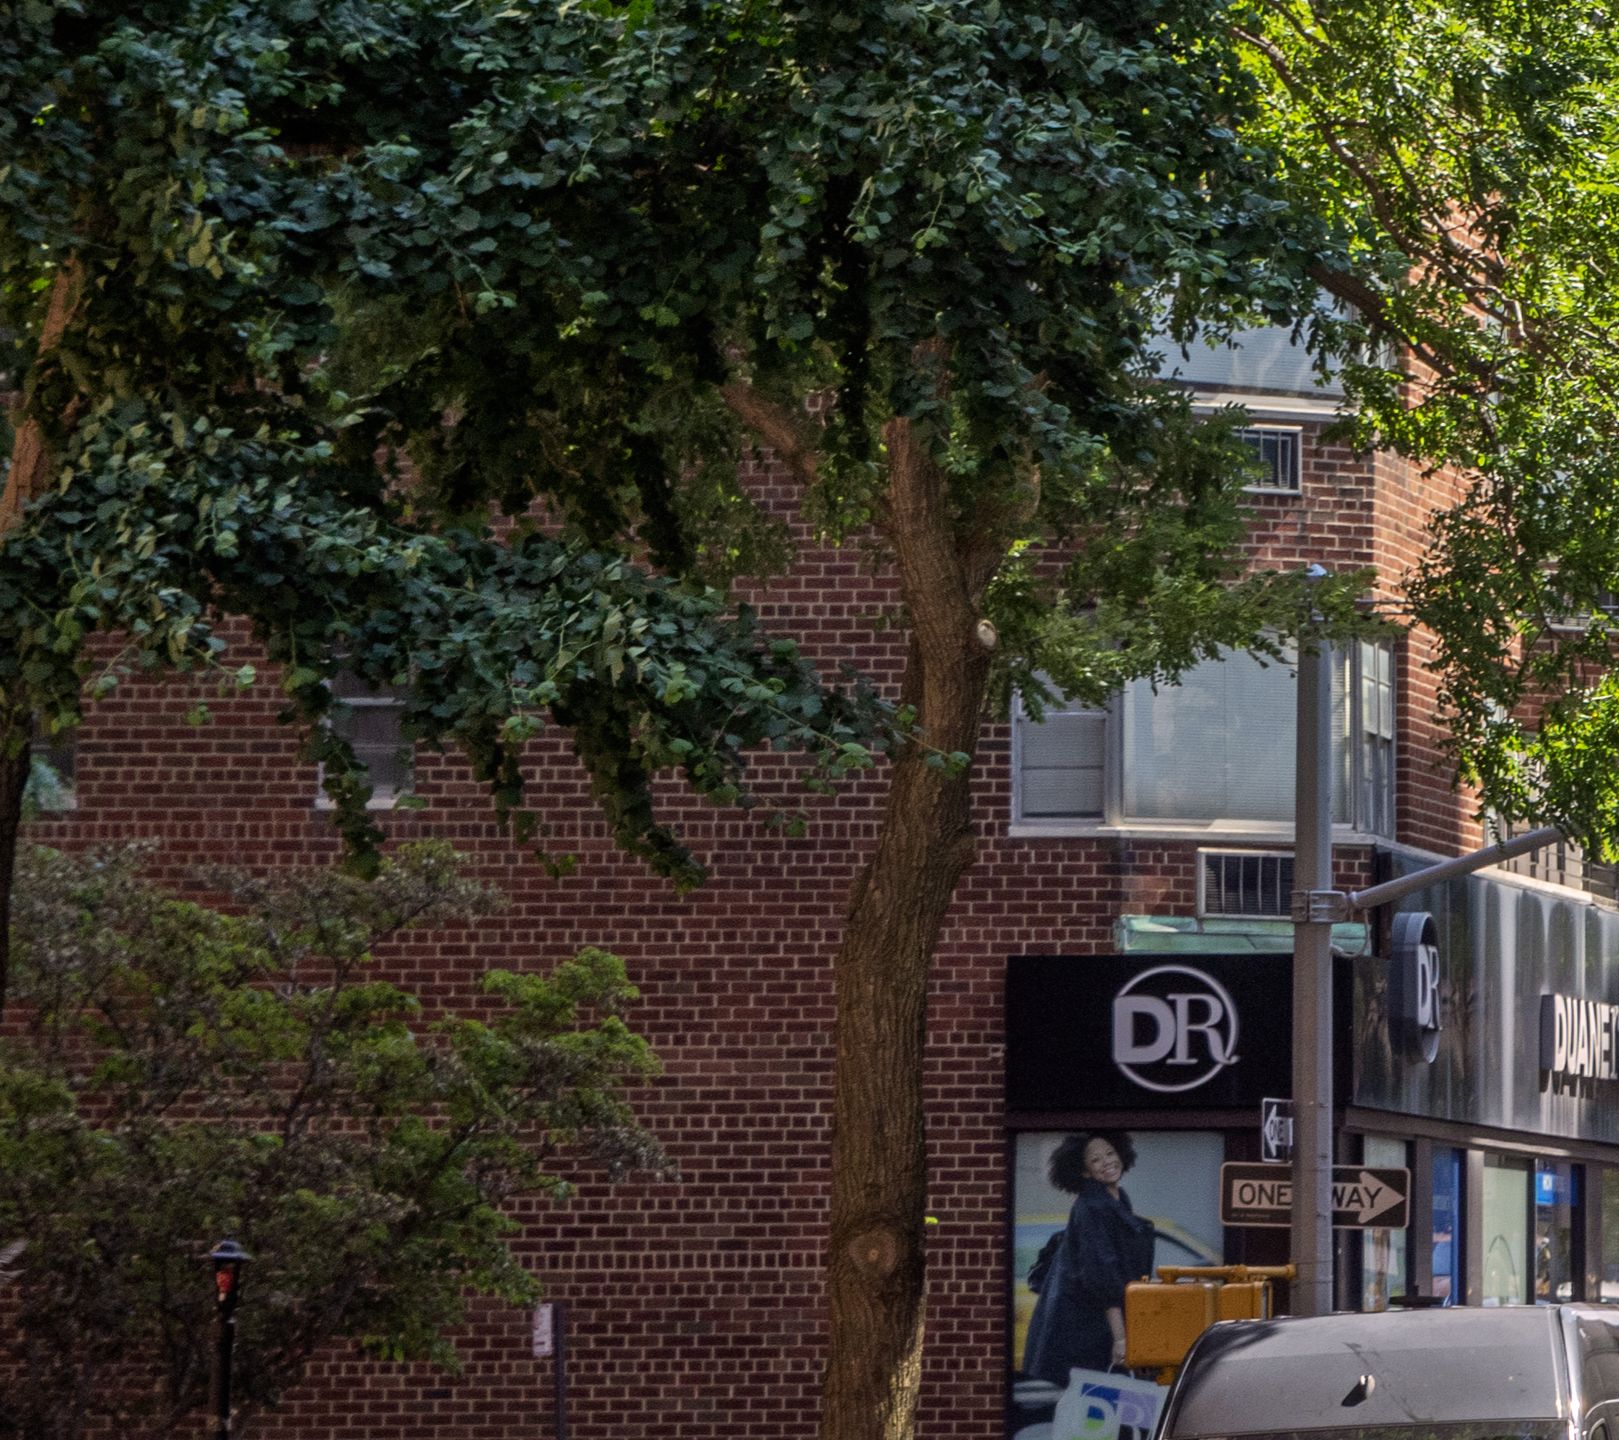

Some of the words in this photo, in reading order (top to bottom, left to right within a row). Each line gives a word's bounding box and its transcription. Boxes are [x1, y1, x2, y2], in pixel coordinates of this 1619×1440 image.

[1416, 944, 1443, 1031] DR
[1112, 993, 1240, 1065] DR
[1239, 1183, 1292, 1206] ONE
